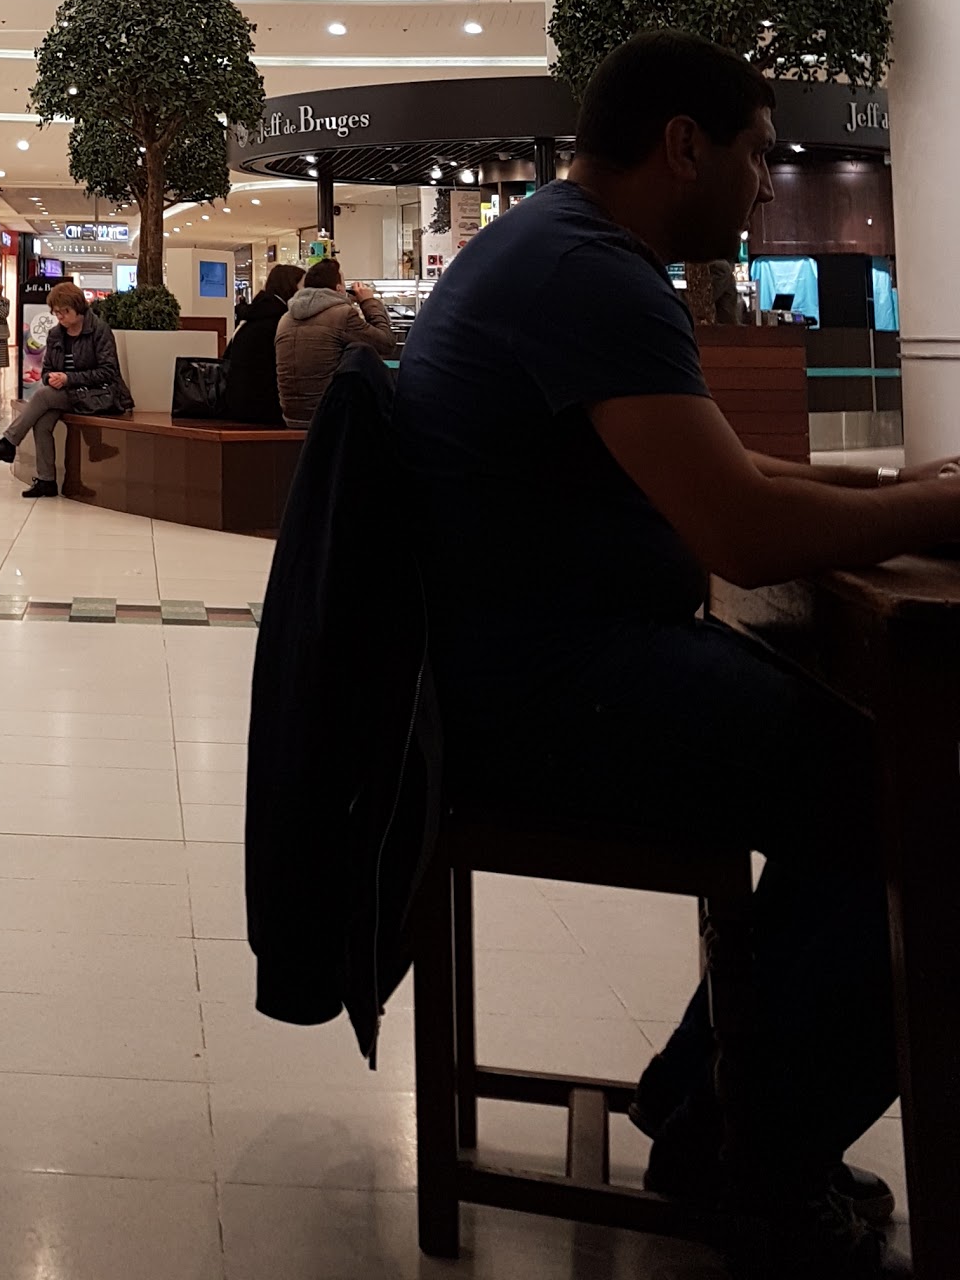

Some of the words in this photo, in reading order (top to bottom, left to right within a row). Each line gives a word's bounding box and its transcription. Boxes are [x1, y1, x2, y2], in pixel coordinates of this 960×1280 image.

[283, 119, 297, 135] de
[297, 105, 371, 138] Bruges
[846, 101, 880, 132] Jeff
[881, 112, 889, 130] d
[25, 283, 38, 292] Jeff
